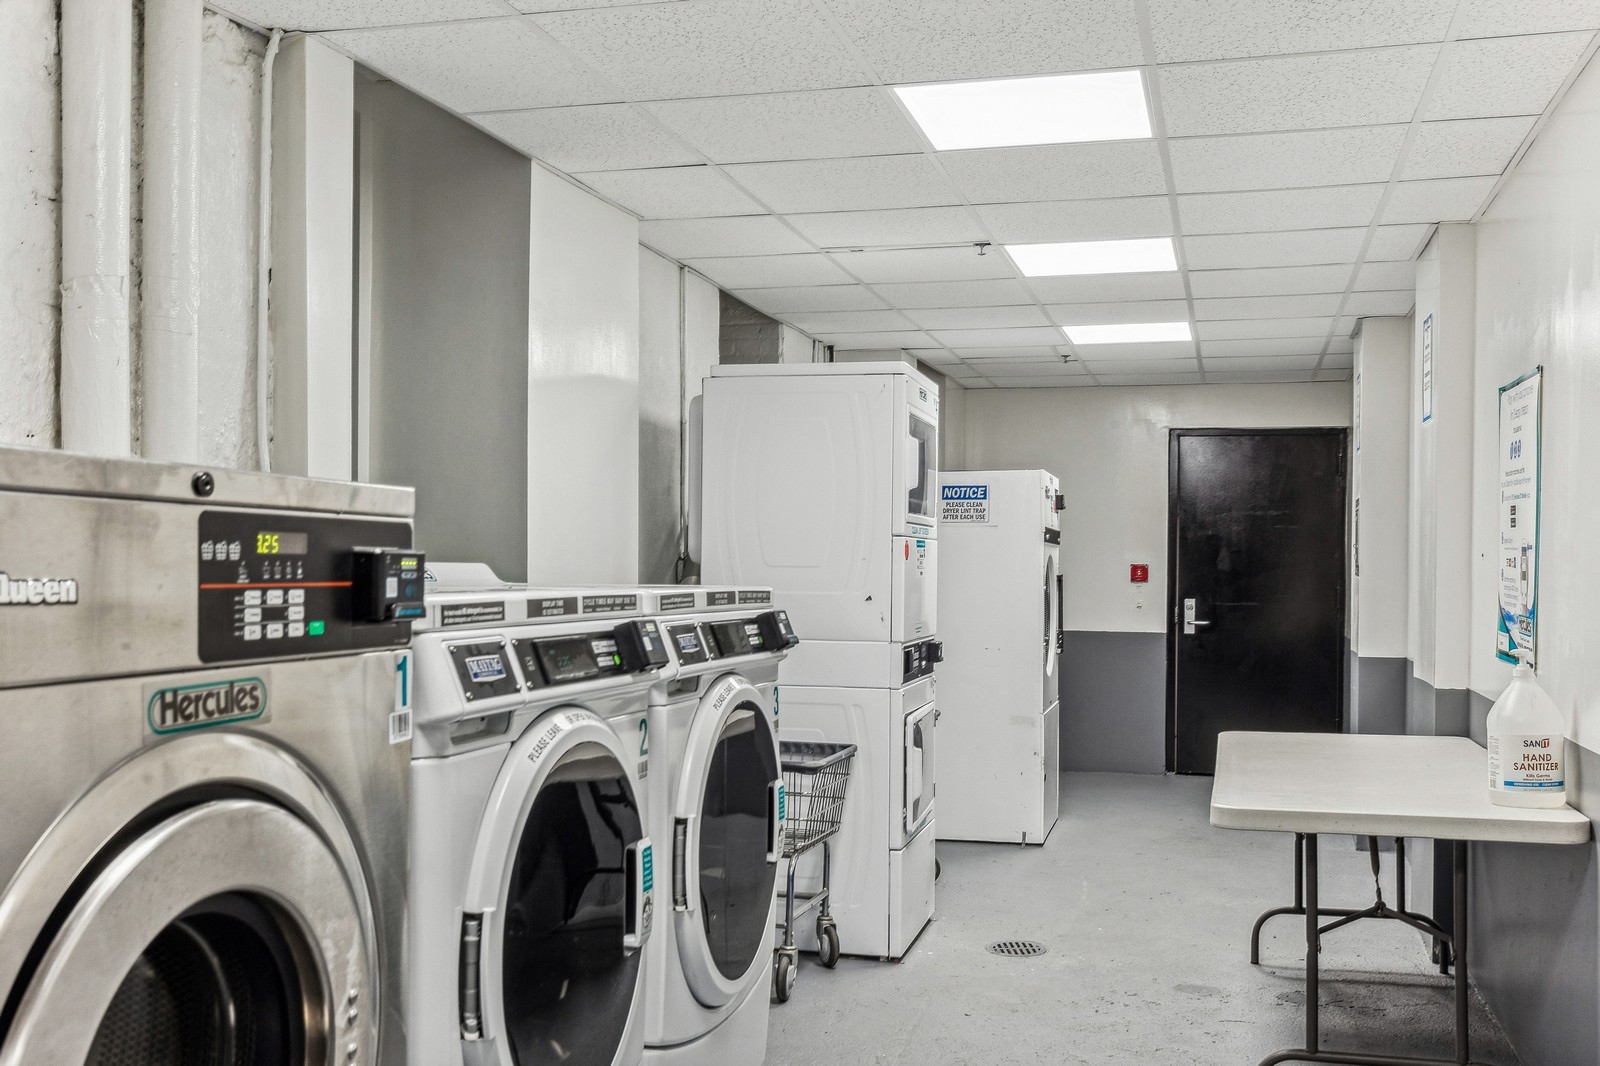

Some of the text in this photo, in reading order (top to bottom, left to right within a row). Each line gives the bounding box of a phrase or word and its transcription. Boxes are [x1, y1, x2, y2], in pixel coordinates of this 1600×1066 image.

[943, 487, 986, 498] NOTICE
[396, 655, 408, 706] 1
[160, 681, 260, 725] Hercules
[712, 692, 727, 711] PLEASE
[773, 686, 779, 716] 3
[639, 718, 648, 757] 2
[527, 738, 549, 763] PLEASE
[1522, 753, 1552, 762] HAND
[1513, 762, 1559, 771] SANITIZER
